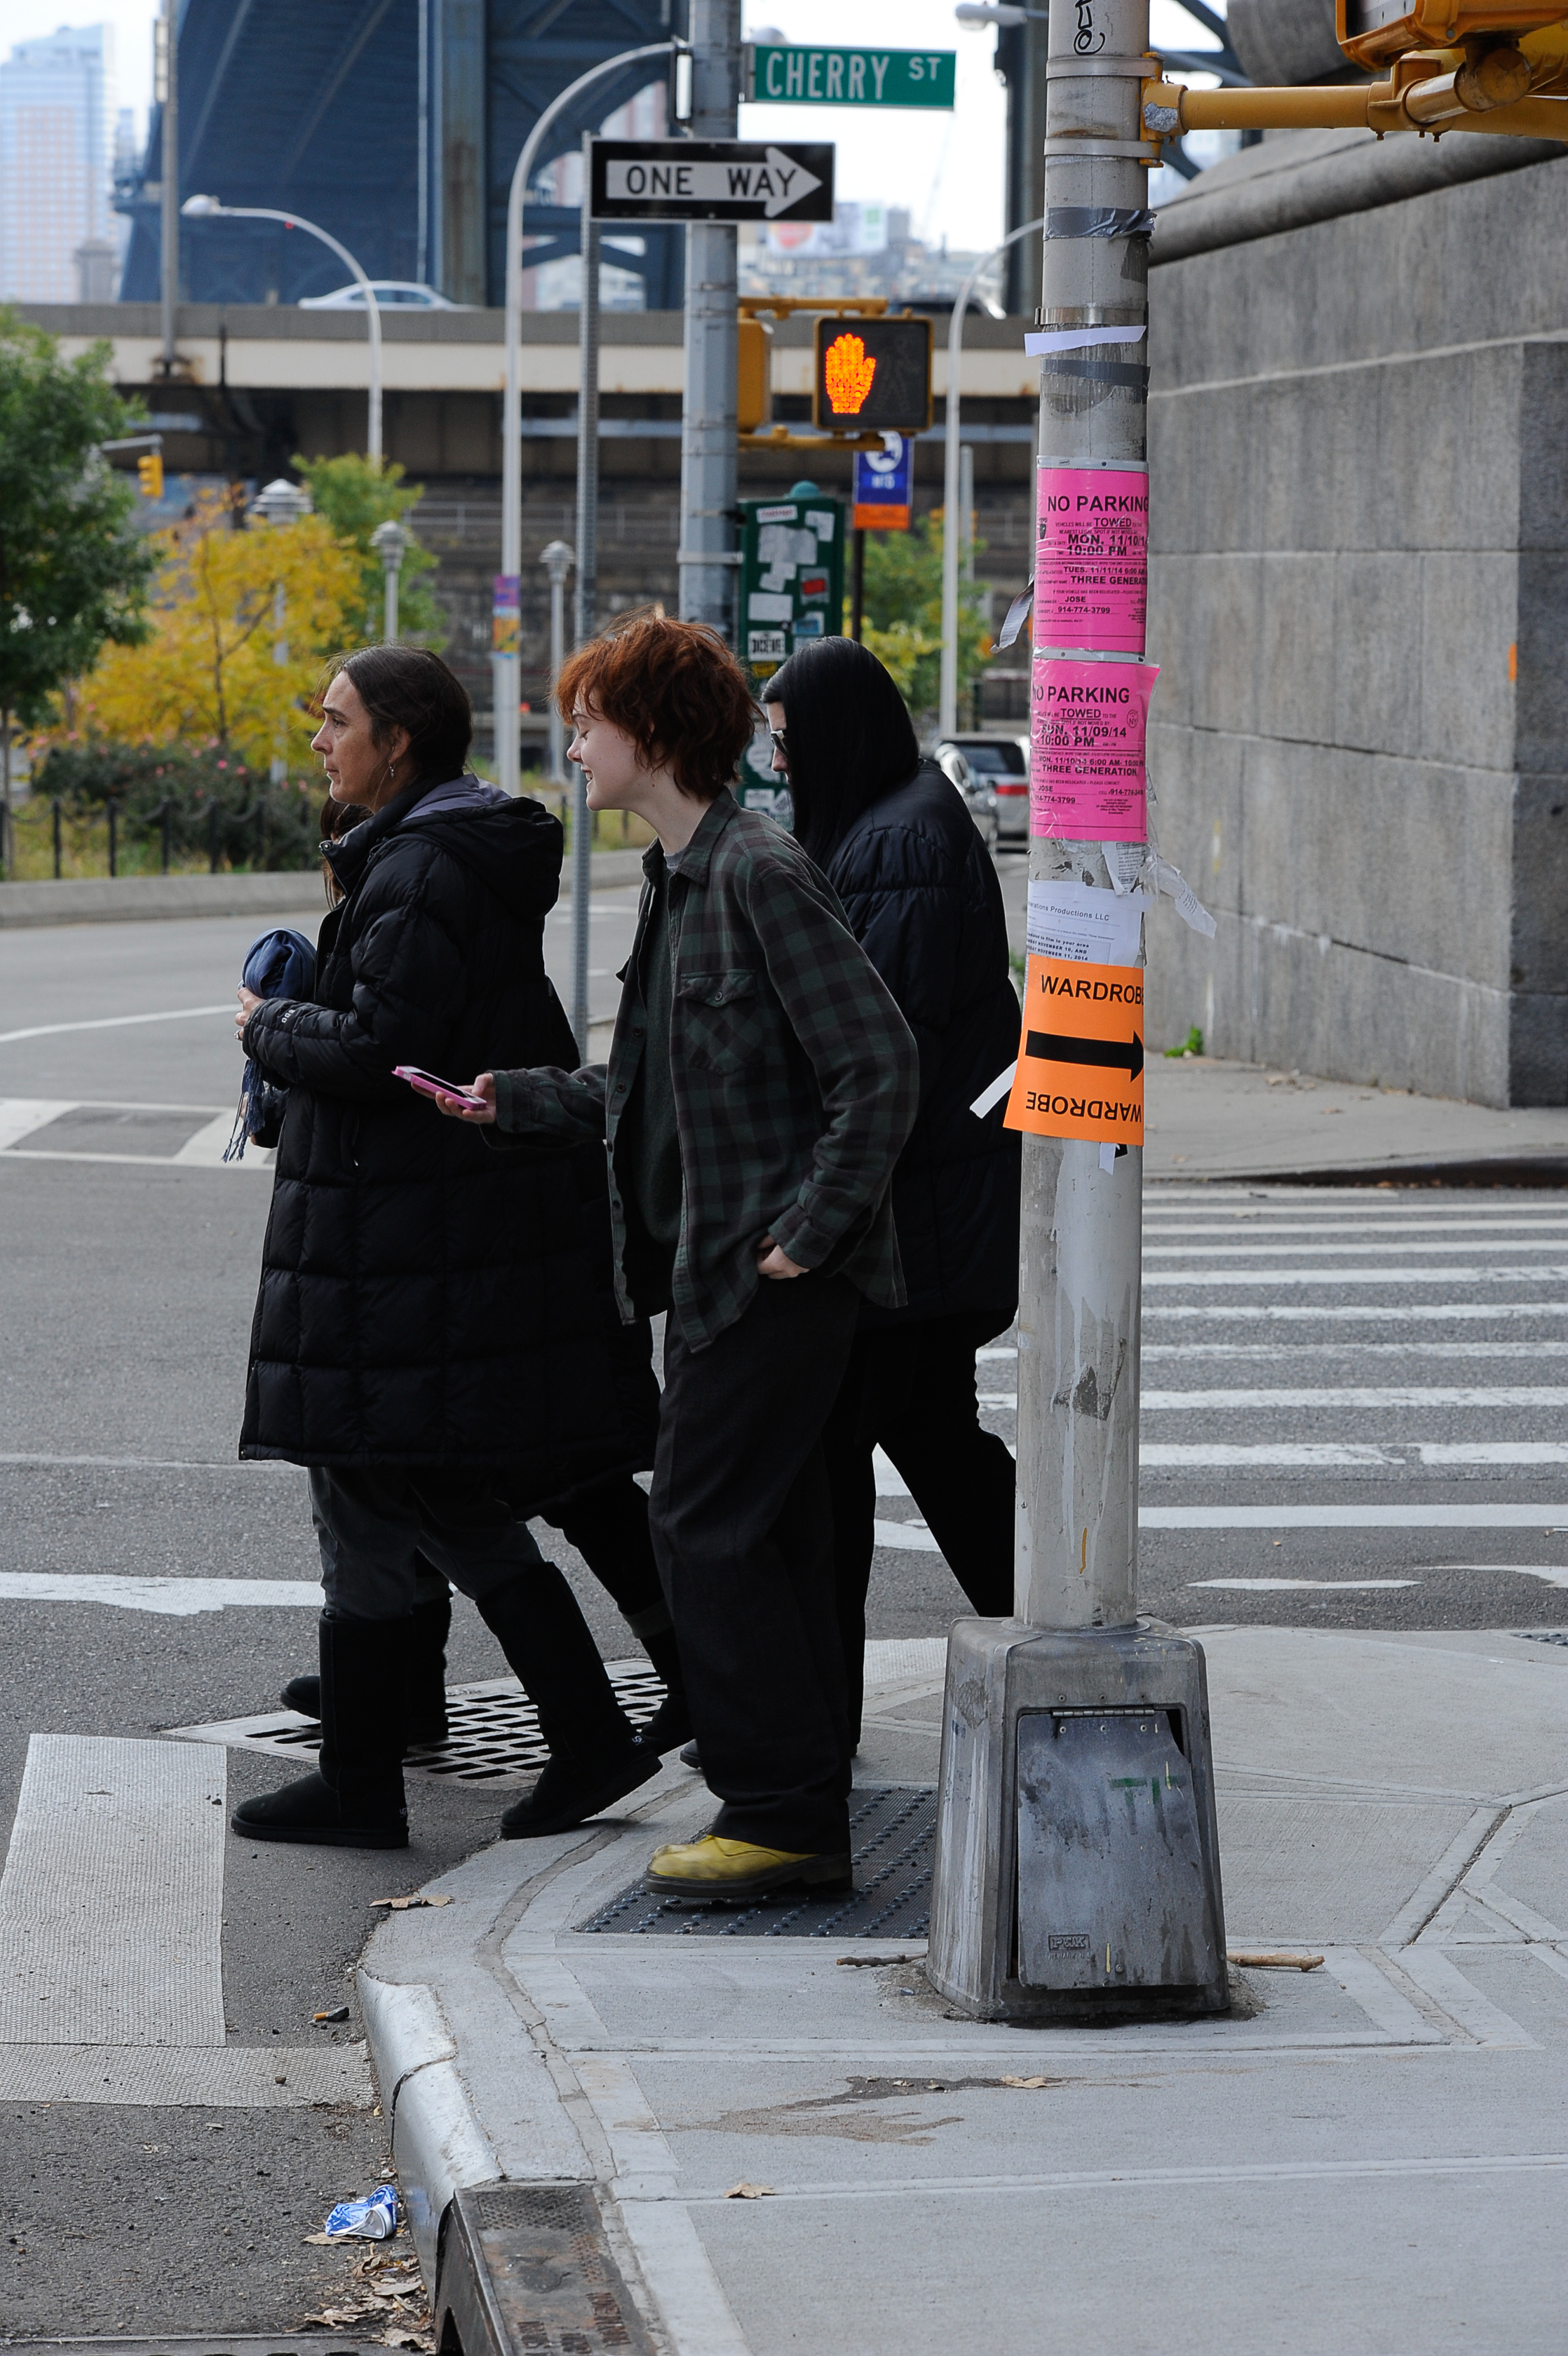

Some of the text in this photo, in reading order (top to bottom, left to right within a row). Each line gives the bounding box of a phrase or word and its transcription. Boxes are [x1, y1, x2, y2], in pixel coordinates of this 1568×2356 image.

[766, 52, 941, 100] CHERRY ST
[626, 165, 797, 197] ONE WAY
[1048, 496, 1149, 513] NO PARKING
[1093, 517, 1132, 527] TOWED
[1068, 534, 1104, 545] MON.
[1067, 545, 1104, 556] 10:00
[1108, 546, 1127, 556] PM
[1070, 576, 1107, 584] THREE
[1057, 606, 1111, 614] 914-774-3799
[1048, 686, 1130, 704] PARKING
[1060, 708, 1102, 719] TOWED
[1041, 724, 1127, 737] SUN. 11/09/14
[1041, 736, 1095, 747] 10:00 PM
[1055, 757, 1087, 765] 11/10/14
[1042, 764, 1137, 776] THREE GENERATION
[1050, 906, 1093, 919] Productions
[1095, 913, 1110, 921] LLC
[1038, 941, 1063, 950] NOVEMBER
[1038, 947, 1062, 957] NOVEMBER
[1041, 974, 1144, 1006] WARDROB
[1025, 1091, 1142, 1123] WARDROBE
